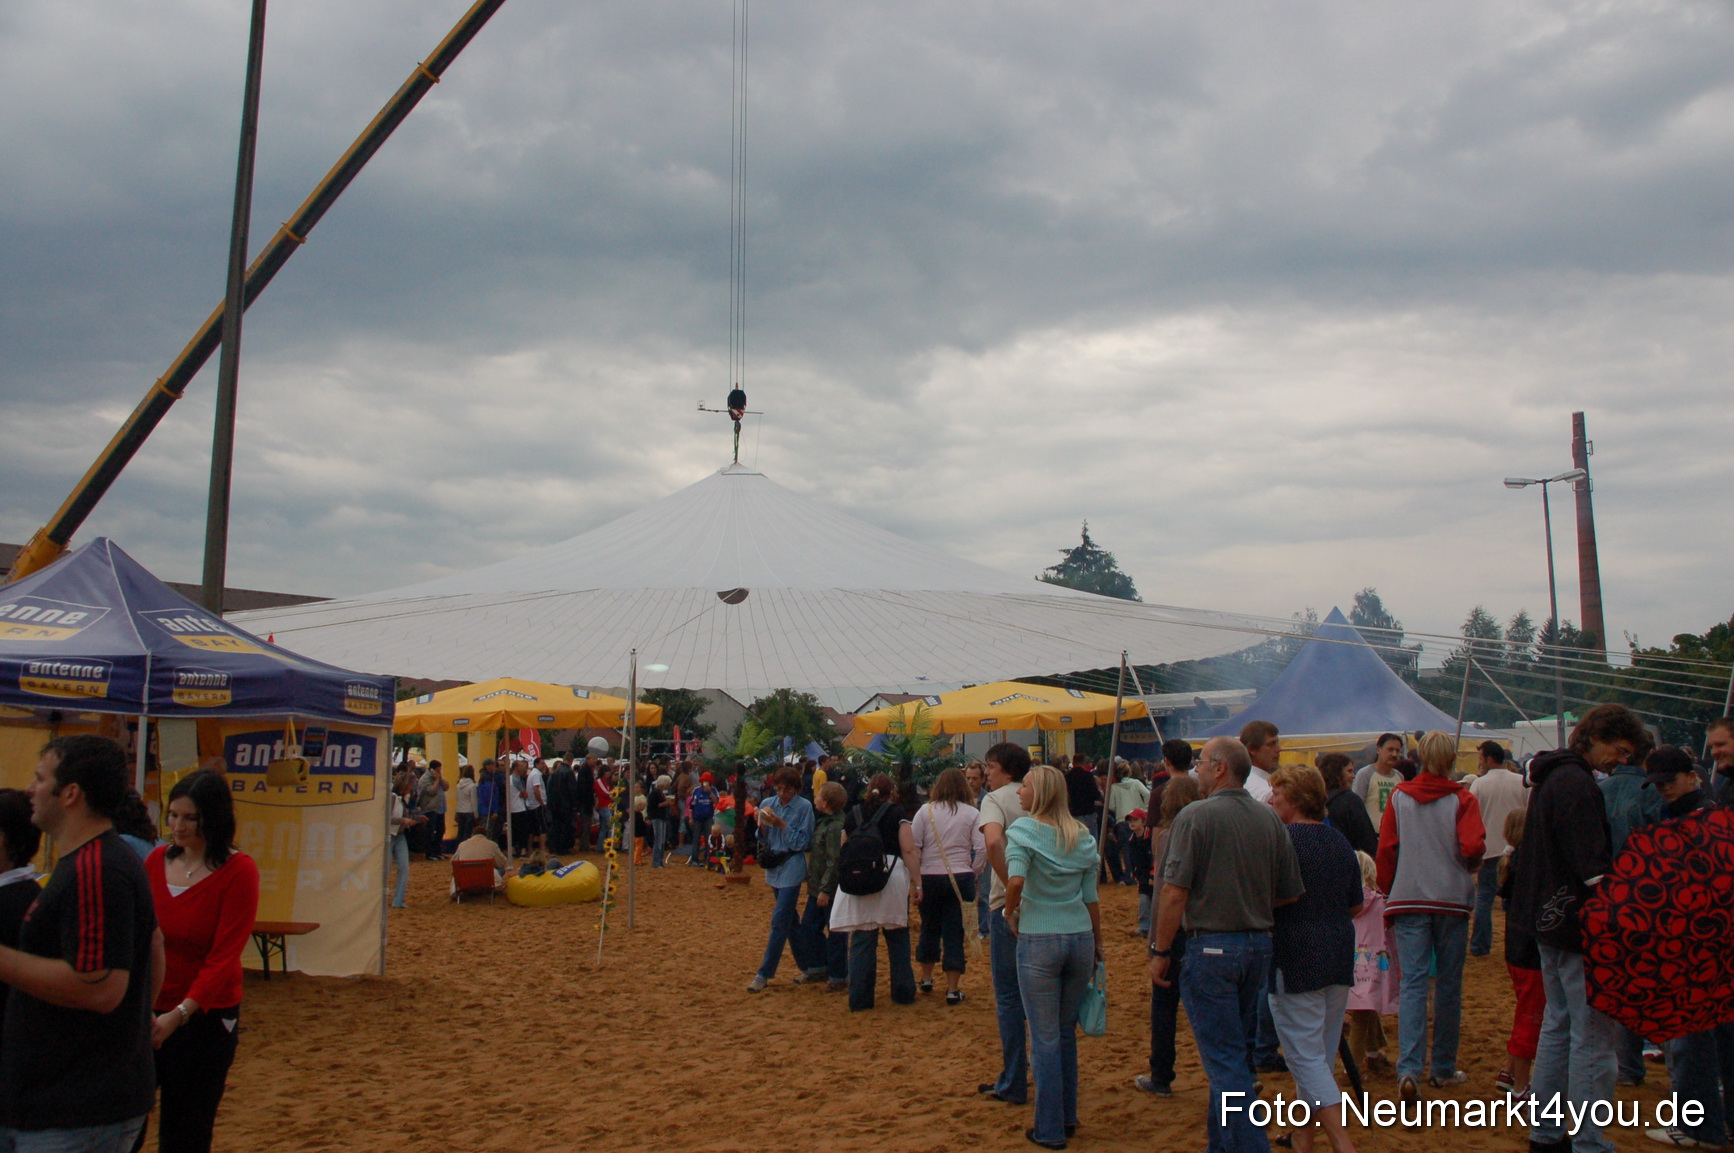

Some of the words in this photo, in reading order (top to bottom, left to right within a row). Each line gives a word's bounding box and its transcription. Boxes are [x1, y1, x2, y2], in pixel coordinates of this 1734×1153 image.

[29, 662, 104, 679] antenne
[178, 671, 228, 687] antenne
[27, 681, 100, 694] BAYERN
[347, 684, 379, 699] antenne
[178, 692, 228, 701] BAYERN
